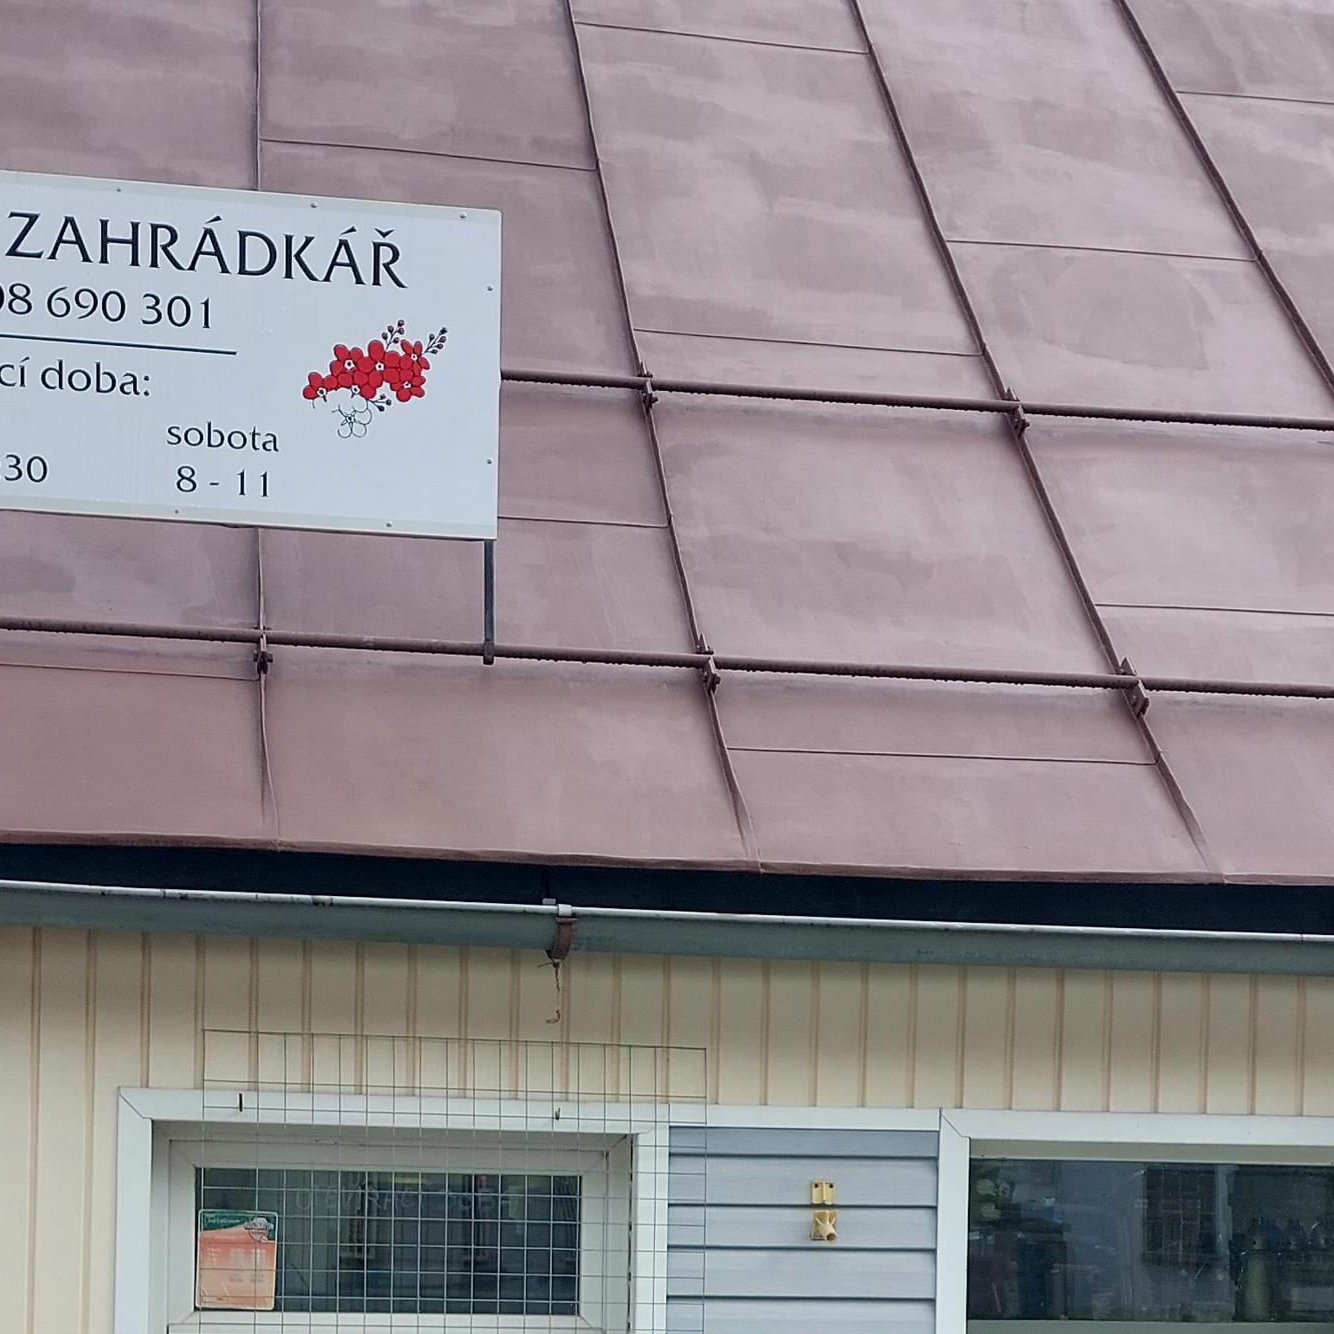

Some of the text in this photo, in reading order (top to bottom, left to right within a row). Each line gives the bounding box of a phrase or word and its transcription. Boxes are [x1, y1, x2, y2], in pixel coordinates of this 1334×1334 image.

[4, 203, 410, 290] ZAHRÁDKÁŘ
[46, 286, 127, 324] 690
[140, 292, 212, 330] 301
[40, 358, 151, 397] doba:
[166, 420, 280, 453] sobota
[176, 464, 198, 493] 8
[235, 469, 269, 498] 11
